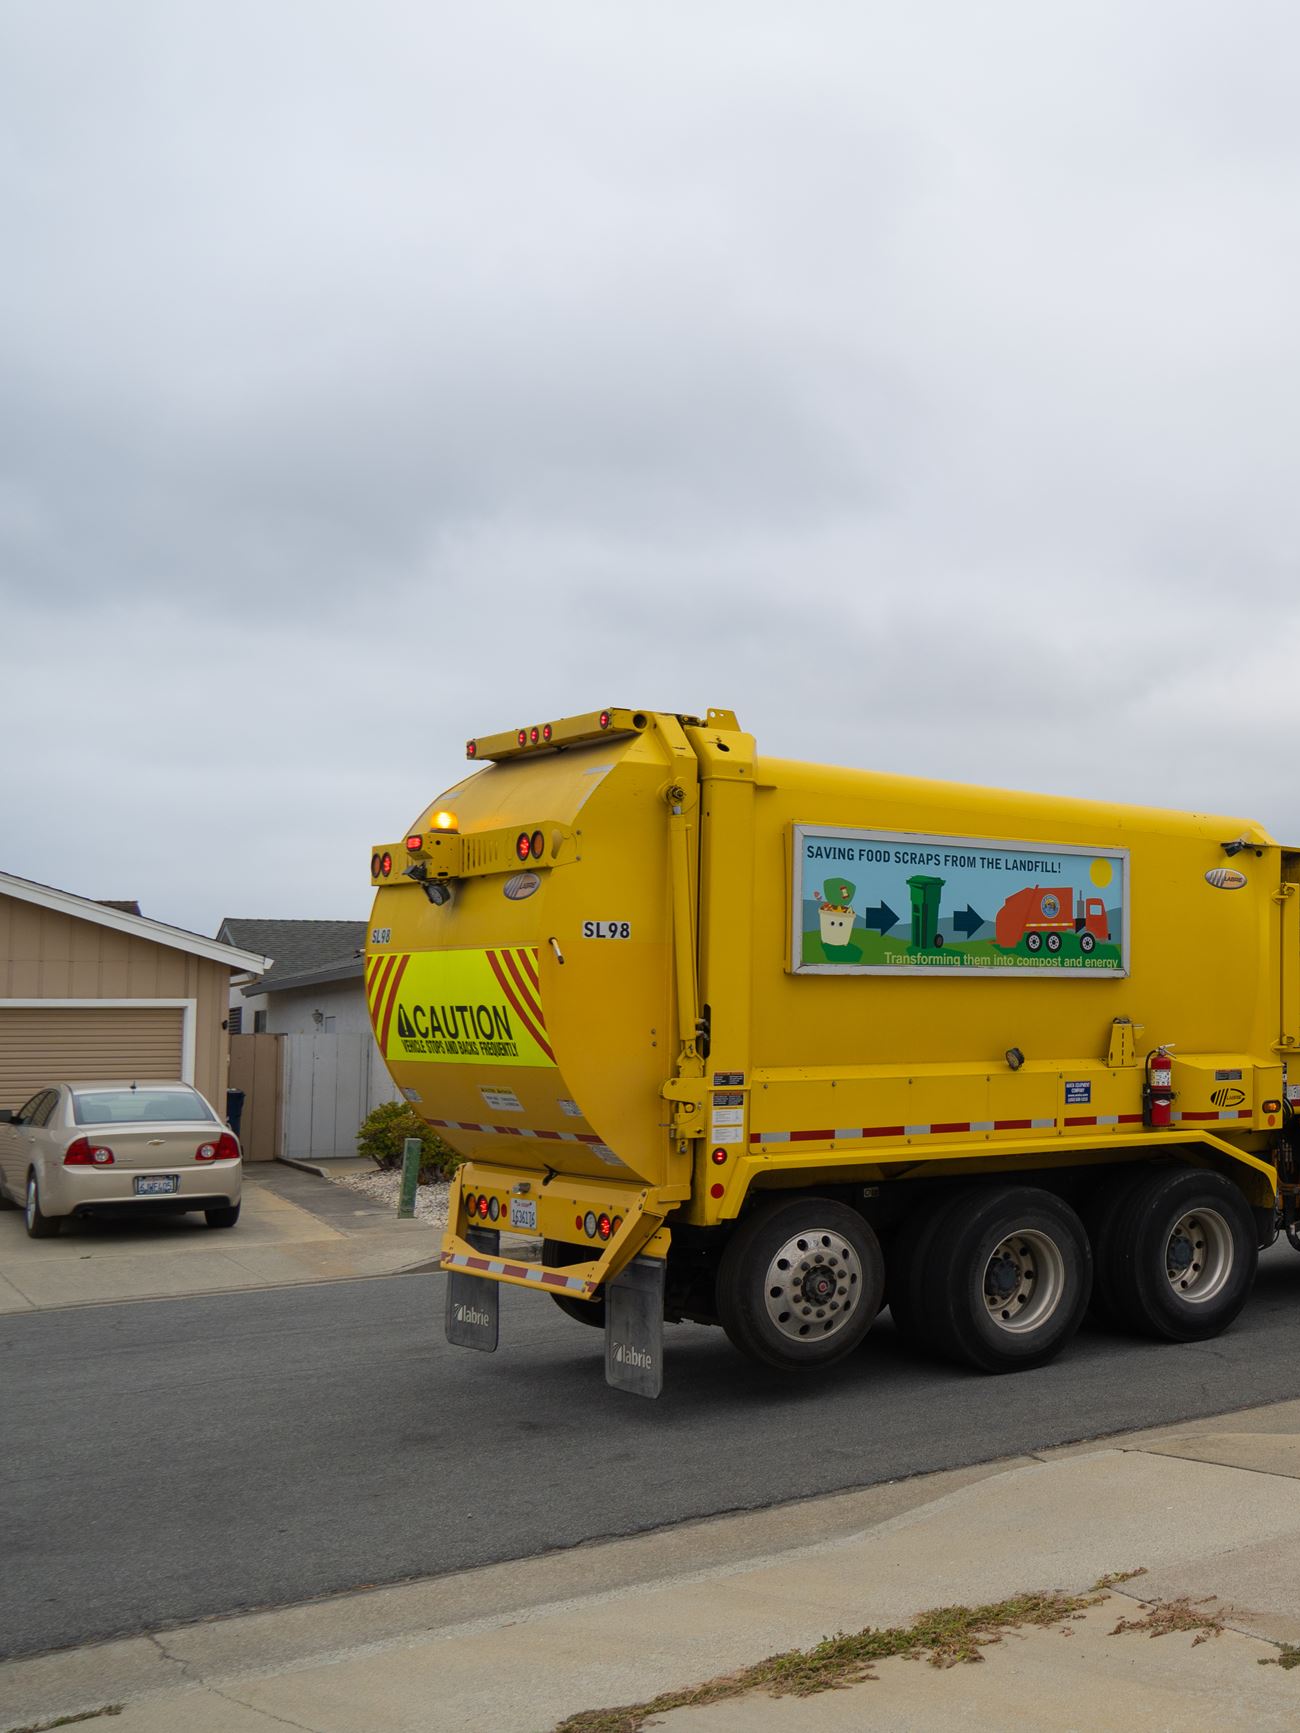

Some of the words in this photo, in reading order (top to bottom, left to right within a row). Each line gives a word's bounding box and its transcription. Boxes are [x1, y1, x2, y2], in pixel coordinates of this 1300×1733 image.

[807, 845, 855, 861] SAVING
[858, 848, 891, 863] FOOD
[894, 851, 941, 866] SCRAPS
[944, 854, 976, 868] FROM
[980, 857, 1002, 870] THE
[1005, 859, 1061, 874] LANDFILL!
[372, 928, 391, 944] SL98
[584, 921, 630, 939] SL98
[884, 951, 961, 966] Transforming
[963, 954, 991, 966] them
[993, 954, 1014, 966] into
[1016, 956, 1062, 967] compost
[1063, 956, 1083, 967] and
[1084, 958, 1119, 969] energy
[413, 1004, 514, 1041] CAUTION
[401, 1039, 427, 1054] VEHICLE
[425, 1040, 446, 1055] STOPS
[444, 1040, 460, 1055] AND
[457, 1041, 480, 1056] BACKS
[479, 1041, 519, 1057] FREQUENTLY
[463, 1304, 490, 1327] labrie
[622, 1344, 653, 1370] labrie
